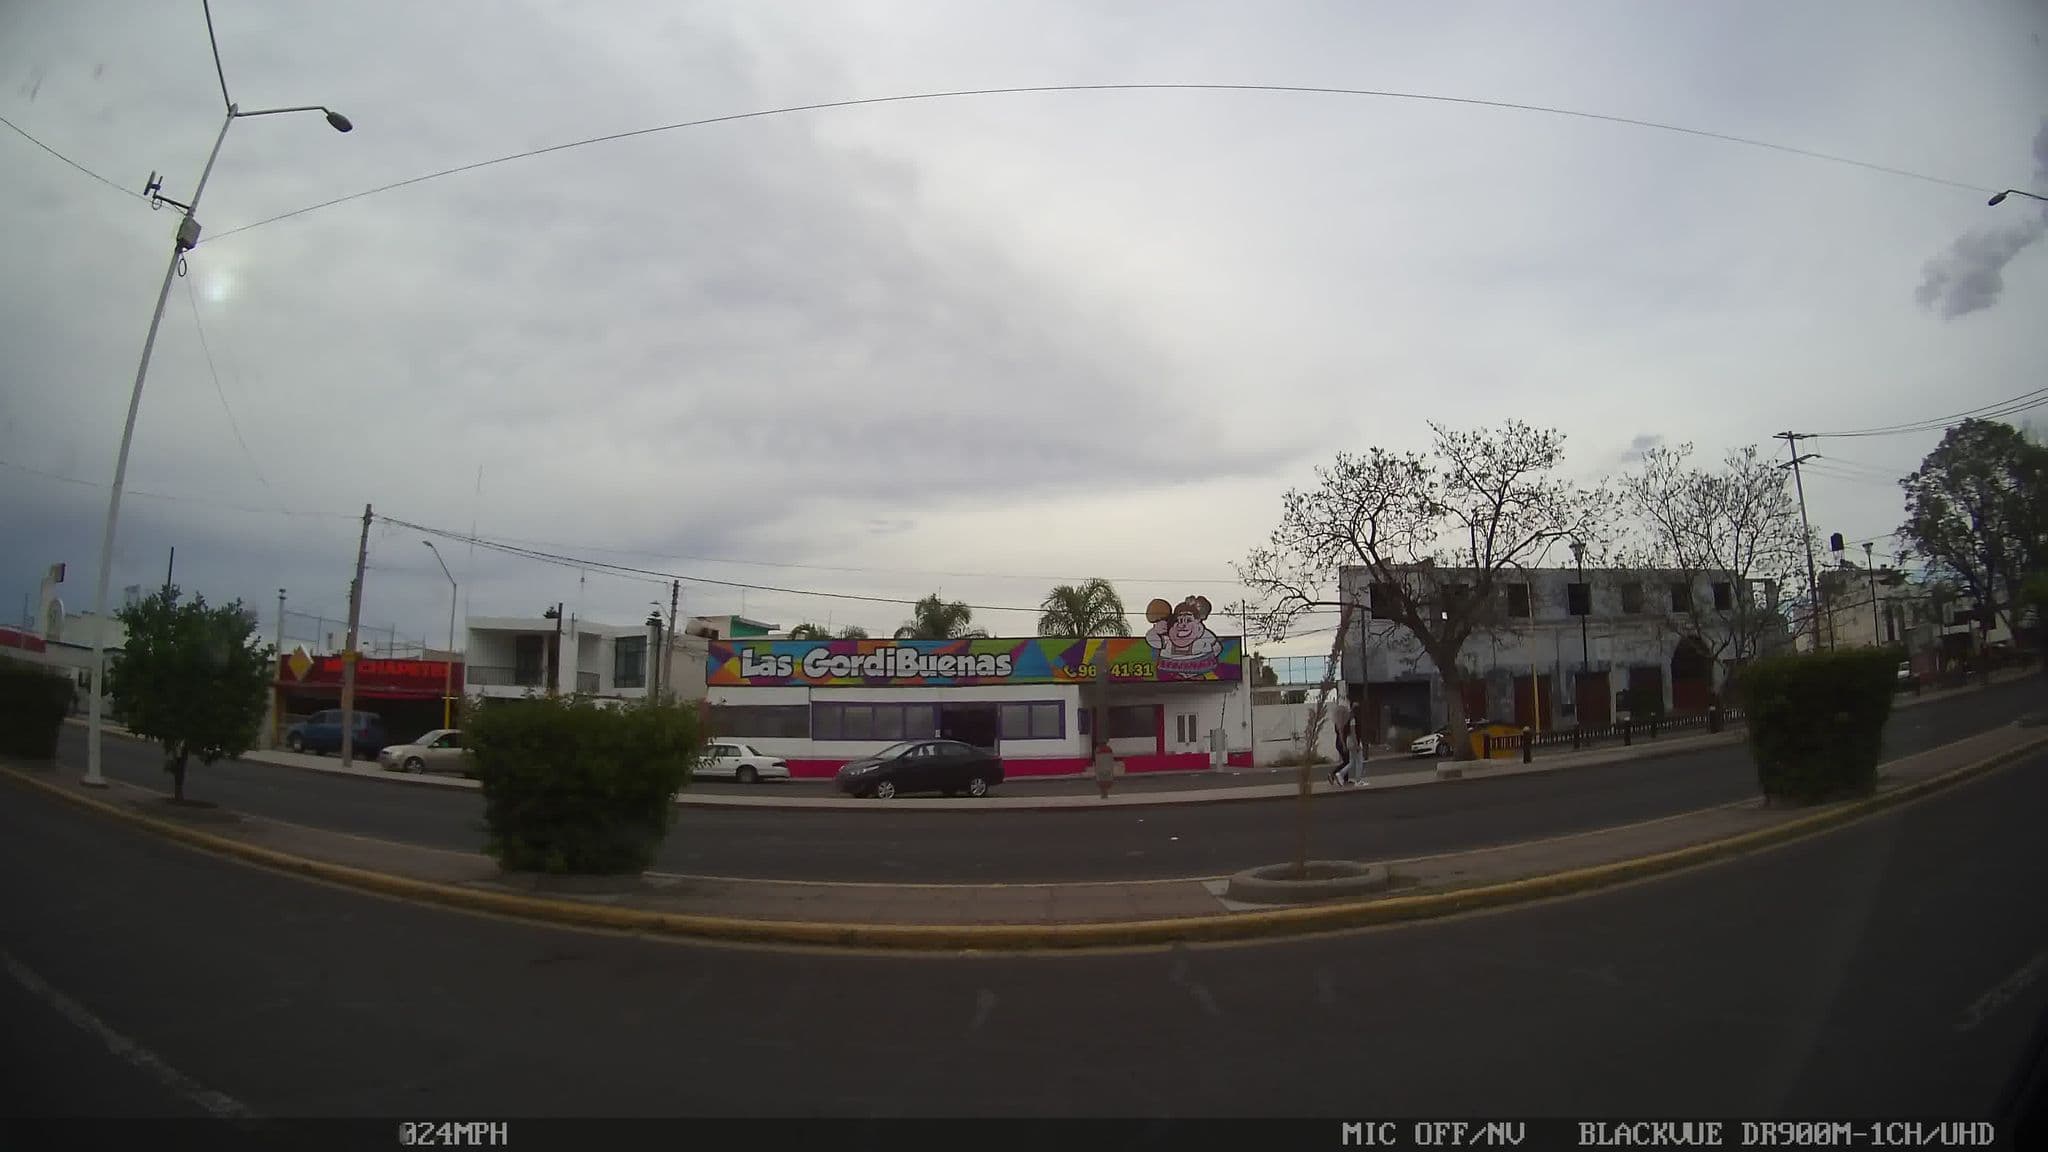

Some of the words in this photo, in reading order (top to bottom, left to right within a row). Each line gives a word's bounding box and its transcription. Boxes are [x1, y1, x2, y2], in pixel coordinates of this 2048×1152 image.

[741, 647, 793, 678] Las
[803, 647, 1013, 679] GordiBuenas
[1111, 664, 1130, 677] 41
[1134, 664, 1153, 677] 31
